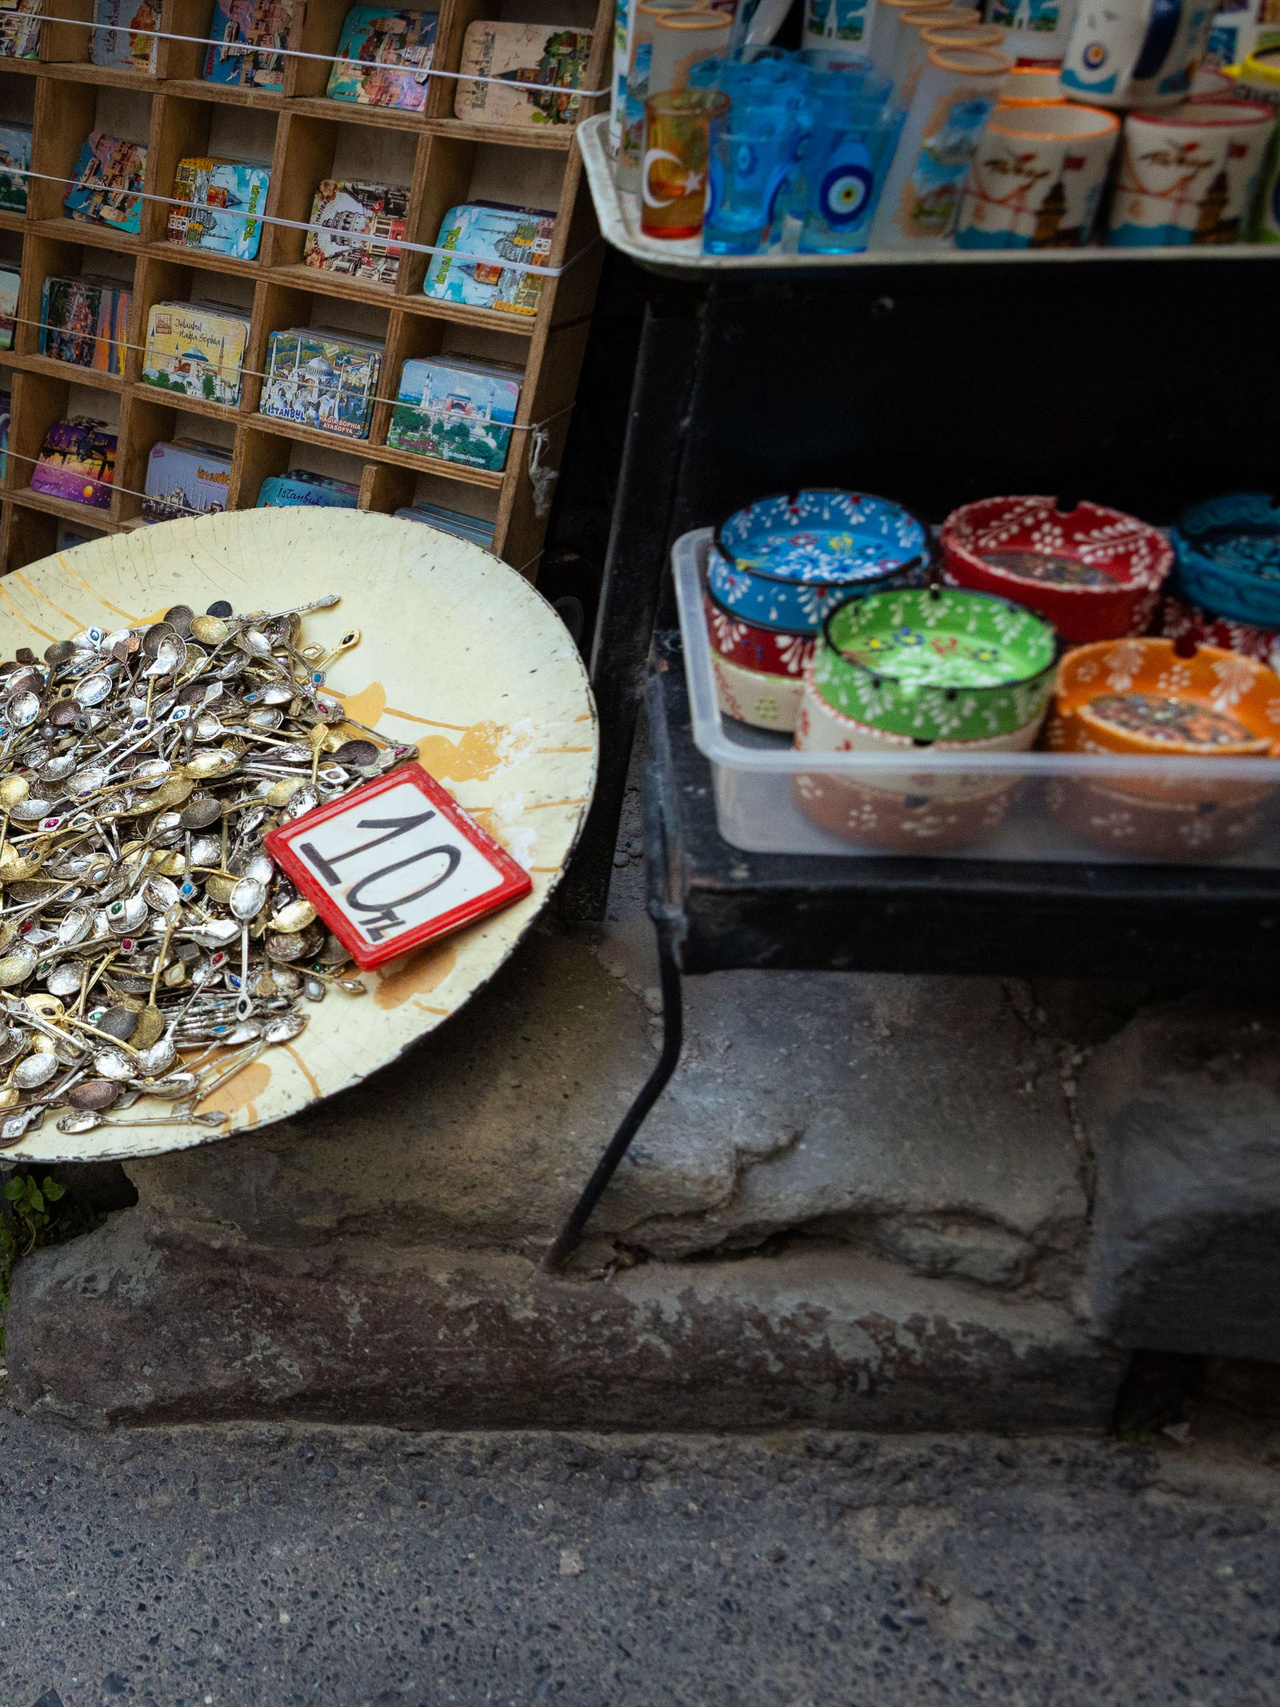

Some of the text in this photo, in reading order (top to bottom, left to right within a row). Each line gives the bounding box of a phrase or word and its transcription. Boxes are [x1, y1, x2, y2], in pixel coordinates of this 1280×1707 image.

[323, 423, 353, 435] AYASOFYA
[339, 420, 362, 430] SOPHIA
[299, 809, 462, 912] 10
[358, 907, 406, 942] TL
